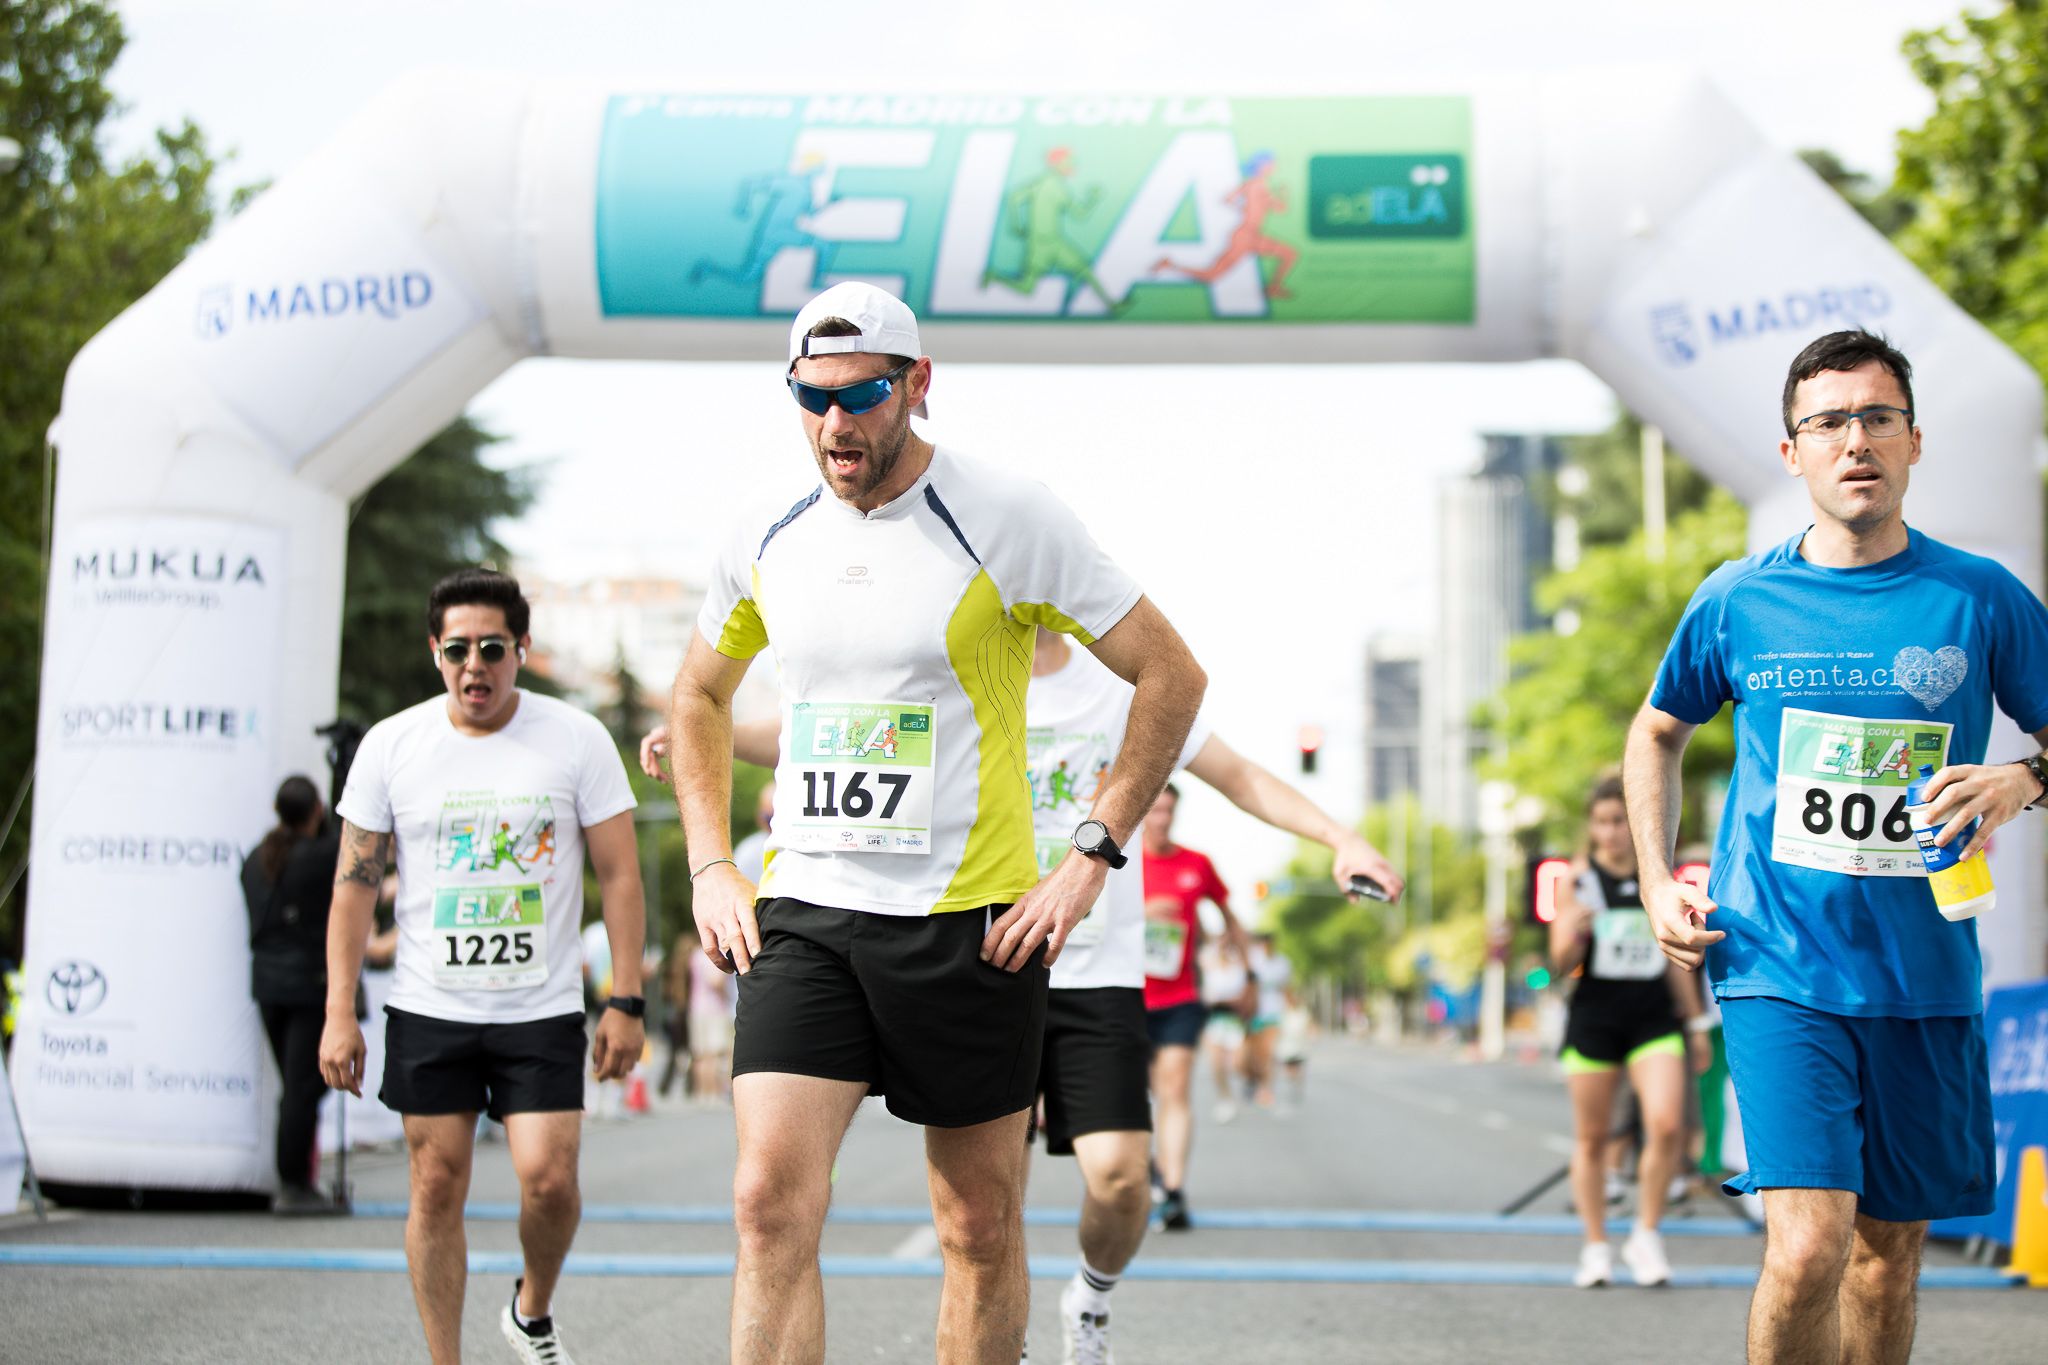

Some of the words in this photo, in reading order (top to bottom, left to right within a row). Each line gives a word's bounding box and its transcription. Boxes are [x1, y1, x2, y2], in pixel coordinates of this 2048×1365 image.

[803, 96, 1024, 124] MADRID
[1034, 97, 1155, 125] CON
[1161, 97, 1234, 125] LA
[760, 128, 1270, 317] ELA
[1326, 187, 1449, 225] adELA
[248, 270, 432, 321] MADRID
[1708, 281, 1893, 343] MADRID
[73, 547, 266, 587] MUKUA
[853, 707, 874, 716] CON
[877, 708, 890, 717] LA
[903, 721, 925, 729] adELA
[1824, 723, 1865, 735] MADRID
[1867, 728, 1889, 736] CON
[1892, 729, 1905, 737] LA
[811, 716, 896, 758] ELA
[1813, 733, 1909, 779] ELA
[803, 771, 912, 819] 1167
[1802, 787, 1913, 842] 806
[456, 895, 522, 925] ELA
[446, 932, 533, 966] 1225
[41, 1032, 109, 1060] Toyota
[148, 1069, 251, 1096] Services
